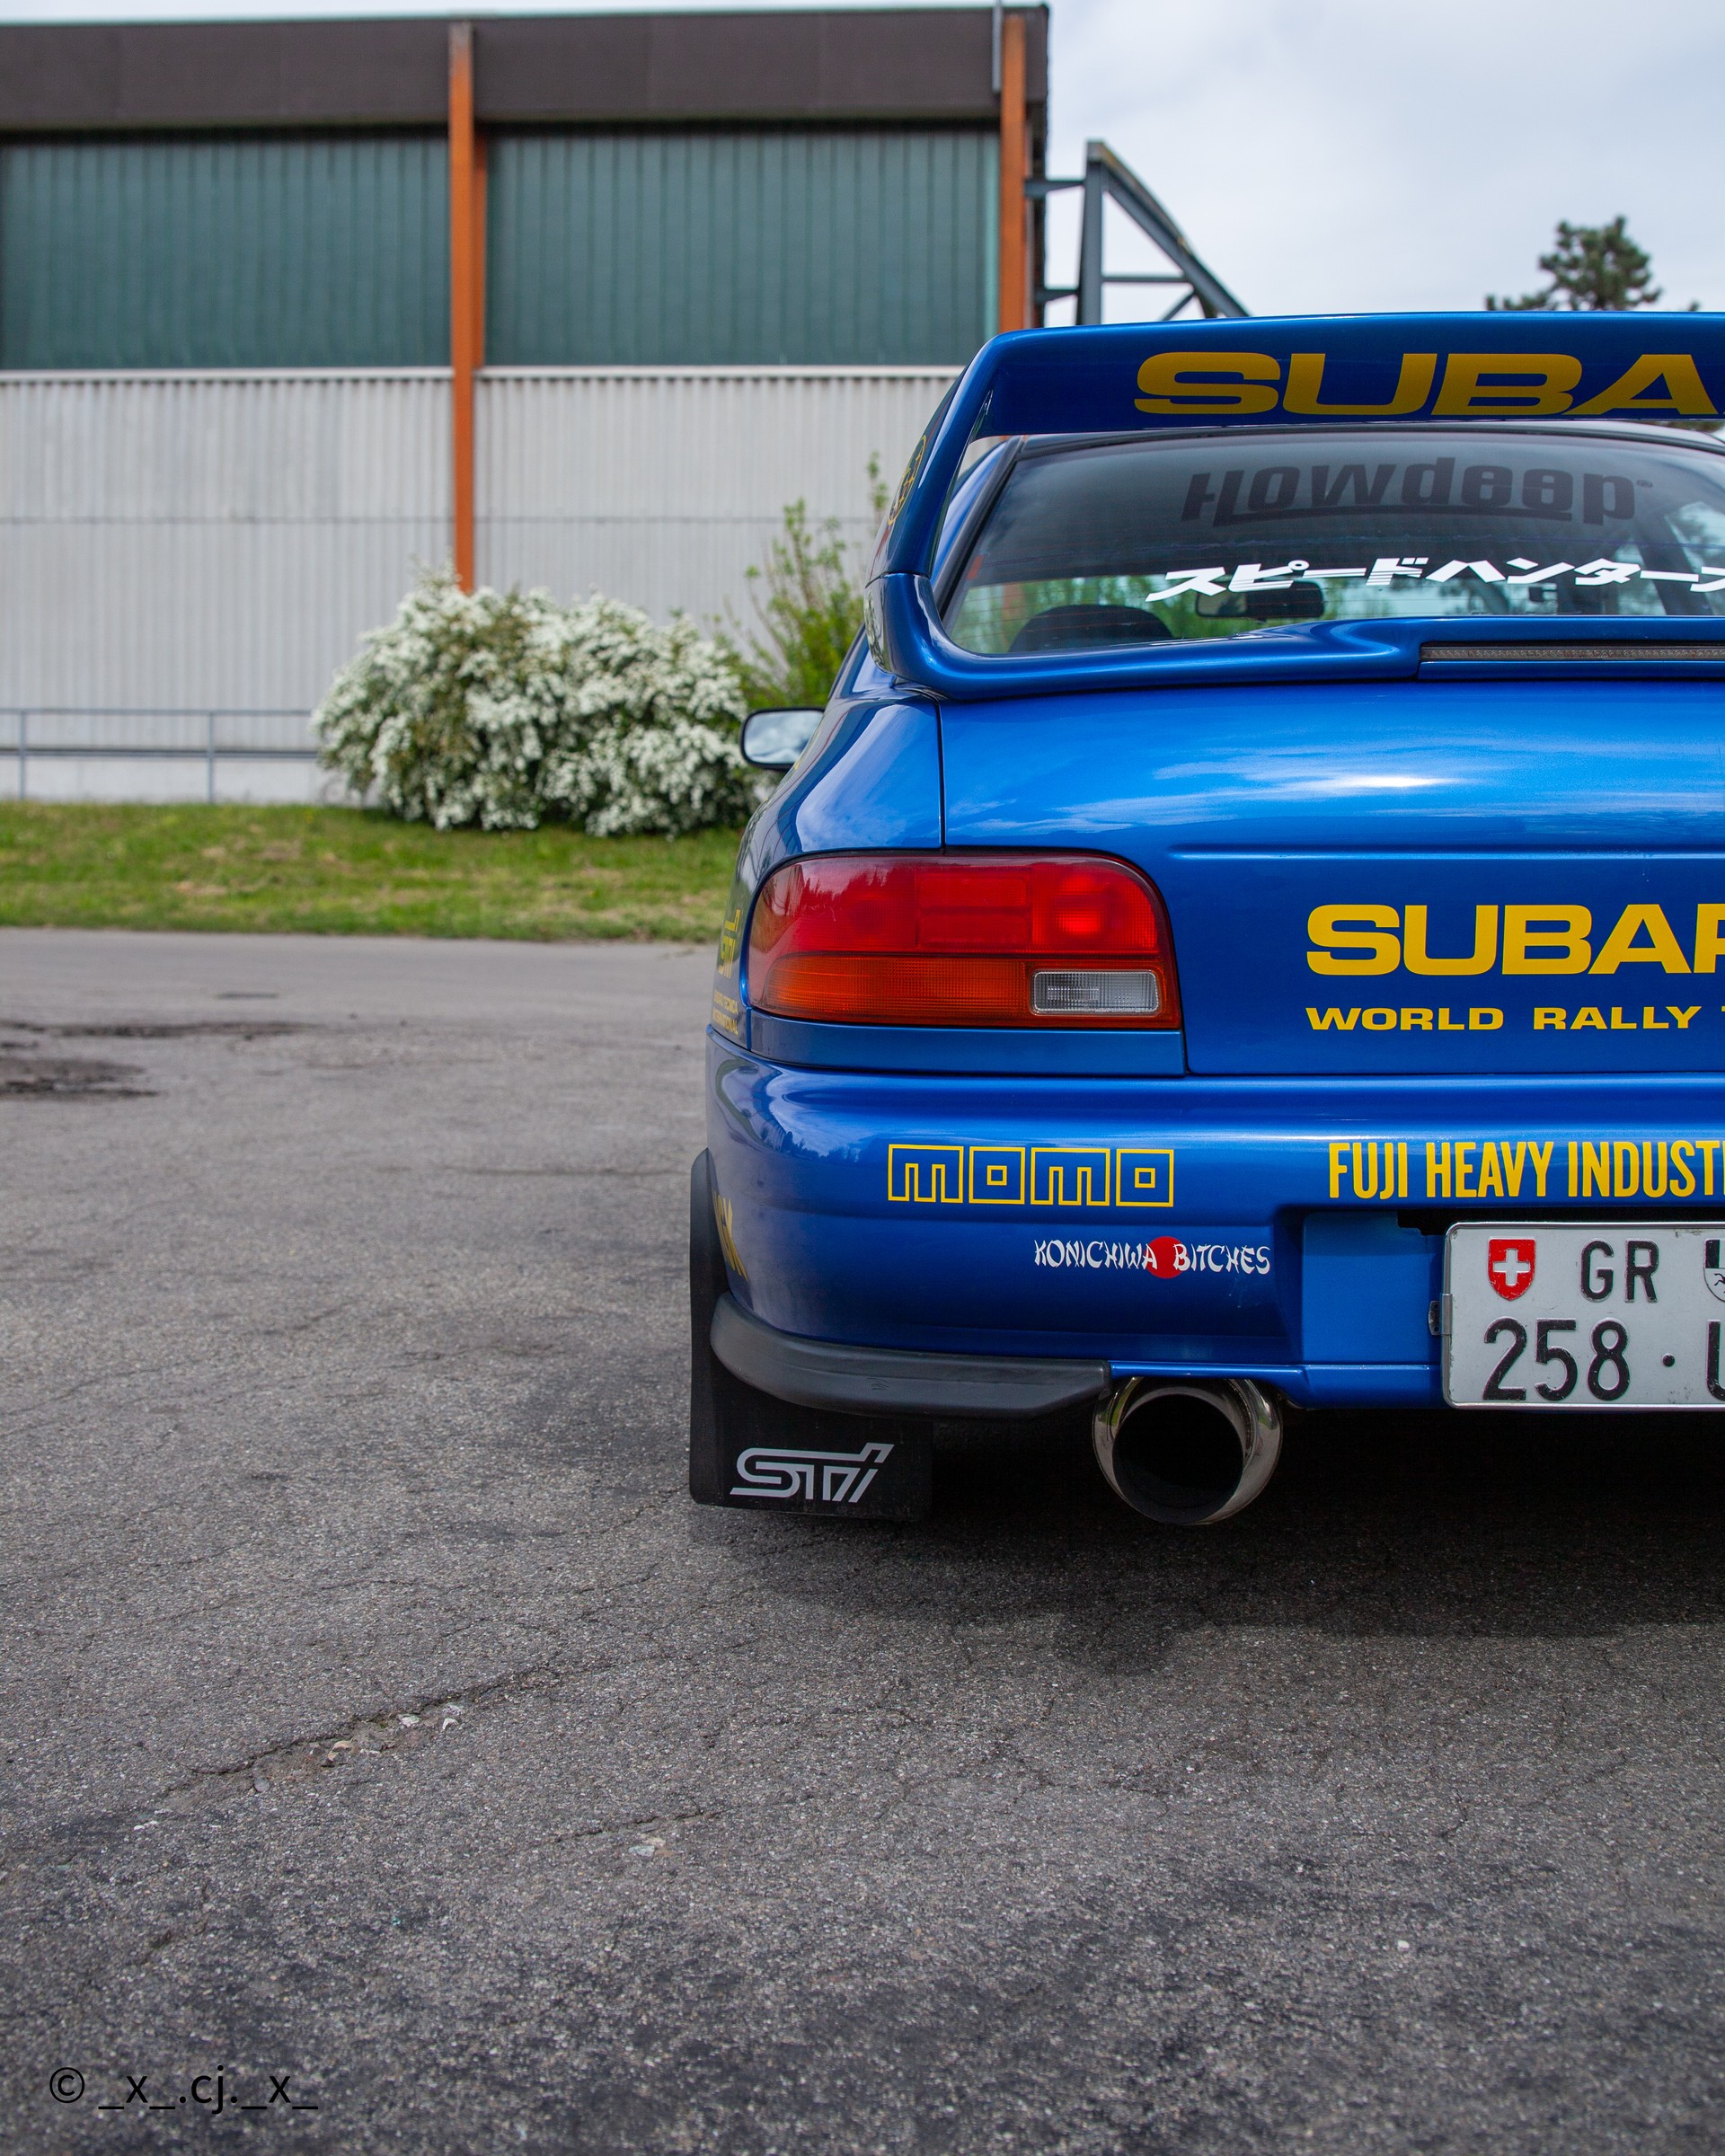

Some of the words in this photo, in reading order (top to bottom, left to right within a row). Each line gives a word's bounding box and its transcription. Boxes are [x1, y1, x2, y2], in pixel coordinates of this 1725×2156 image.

[1135, 351, 1725, 415] SUBA
[1305, 1007, 1504, 1030] WORLD
[1533, 1006, 1702, 1029] RALLY
[1329, 1143, 1408, 1200] FUJI
[1426, 1142, 1554, 1198] HEAVY
[1568, 1139, 1725, 1197] INDUST
[1034, 1239, 1158, 1270] KONICHIWA
[1172, 1242, 1271, 1275] BITCHES
[1580, 1239, 1659, 1303] GR
[1482, 1317, 1632, 1401] 258
